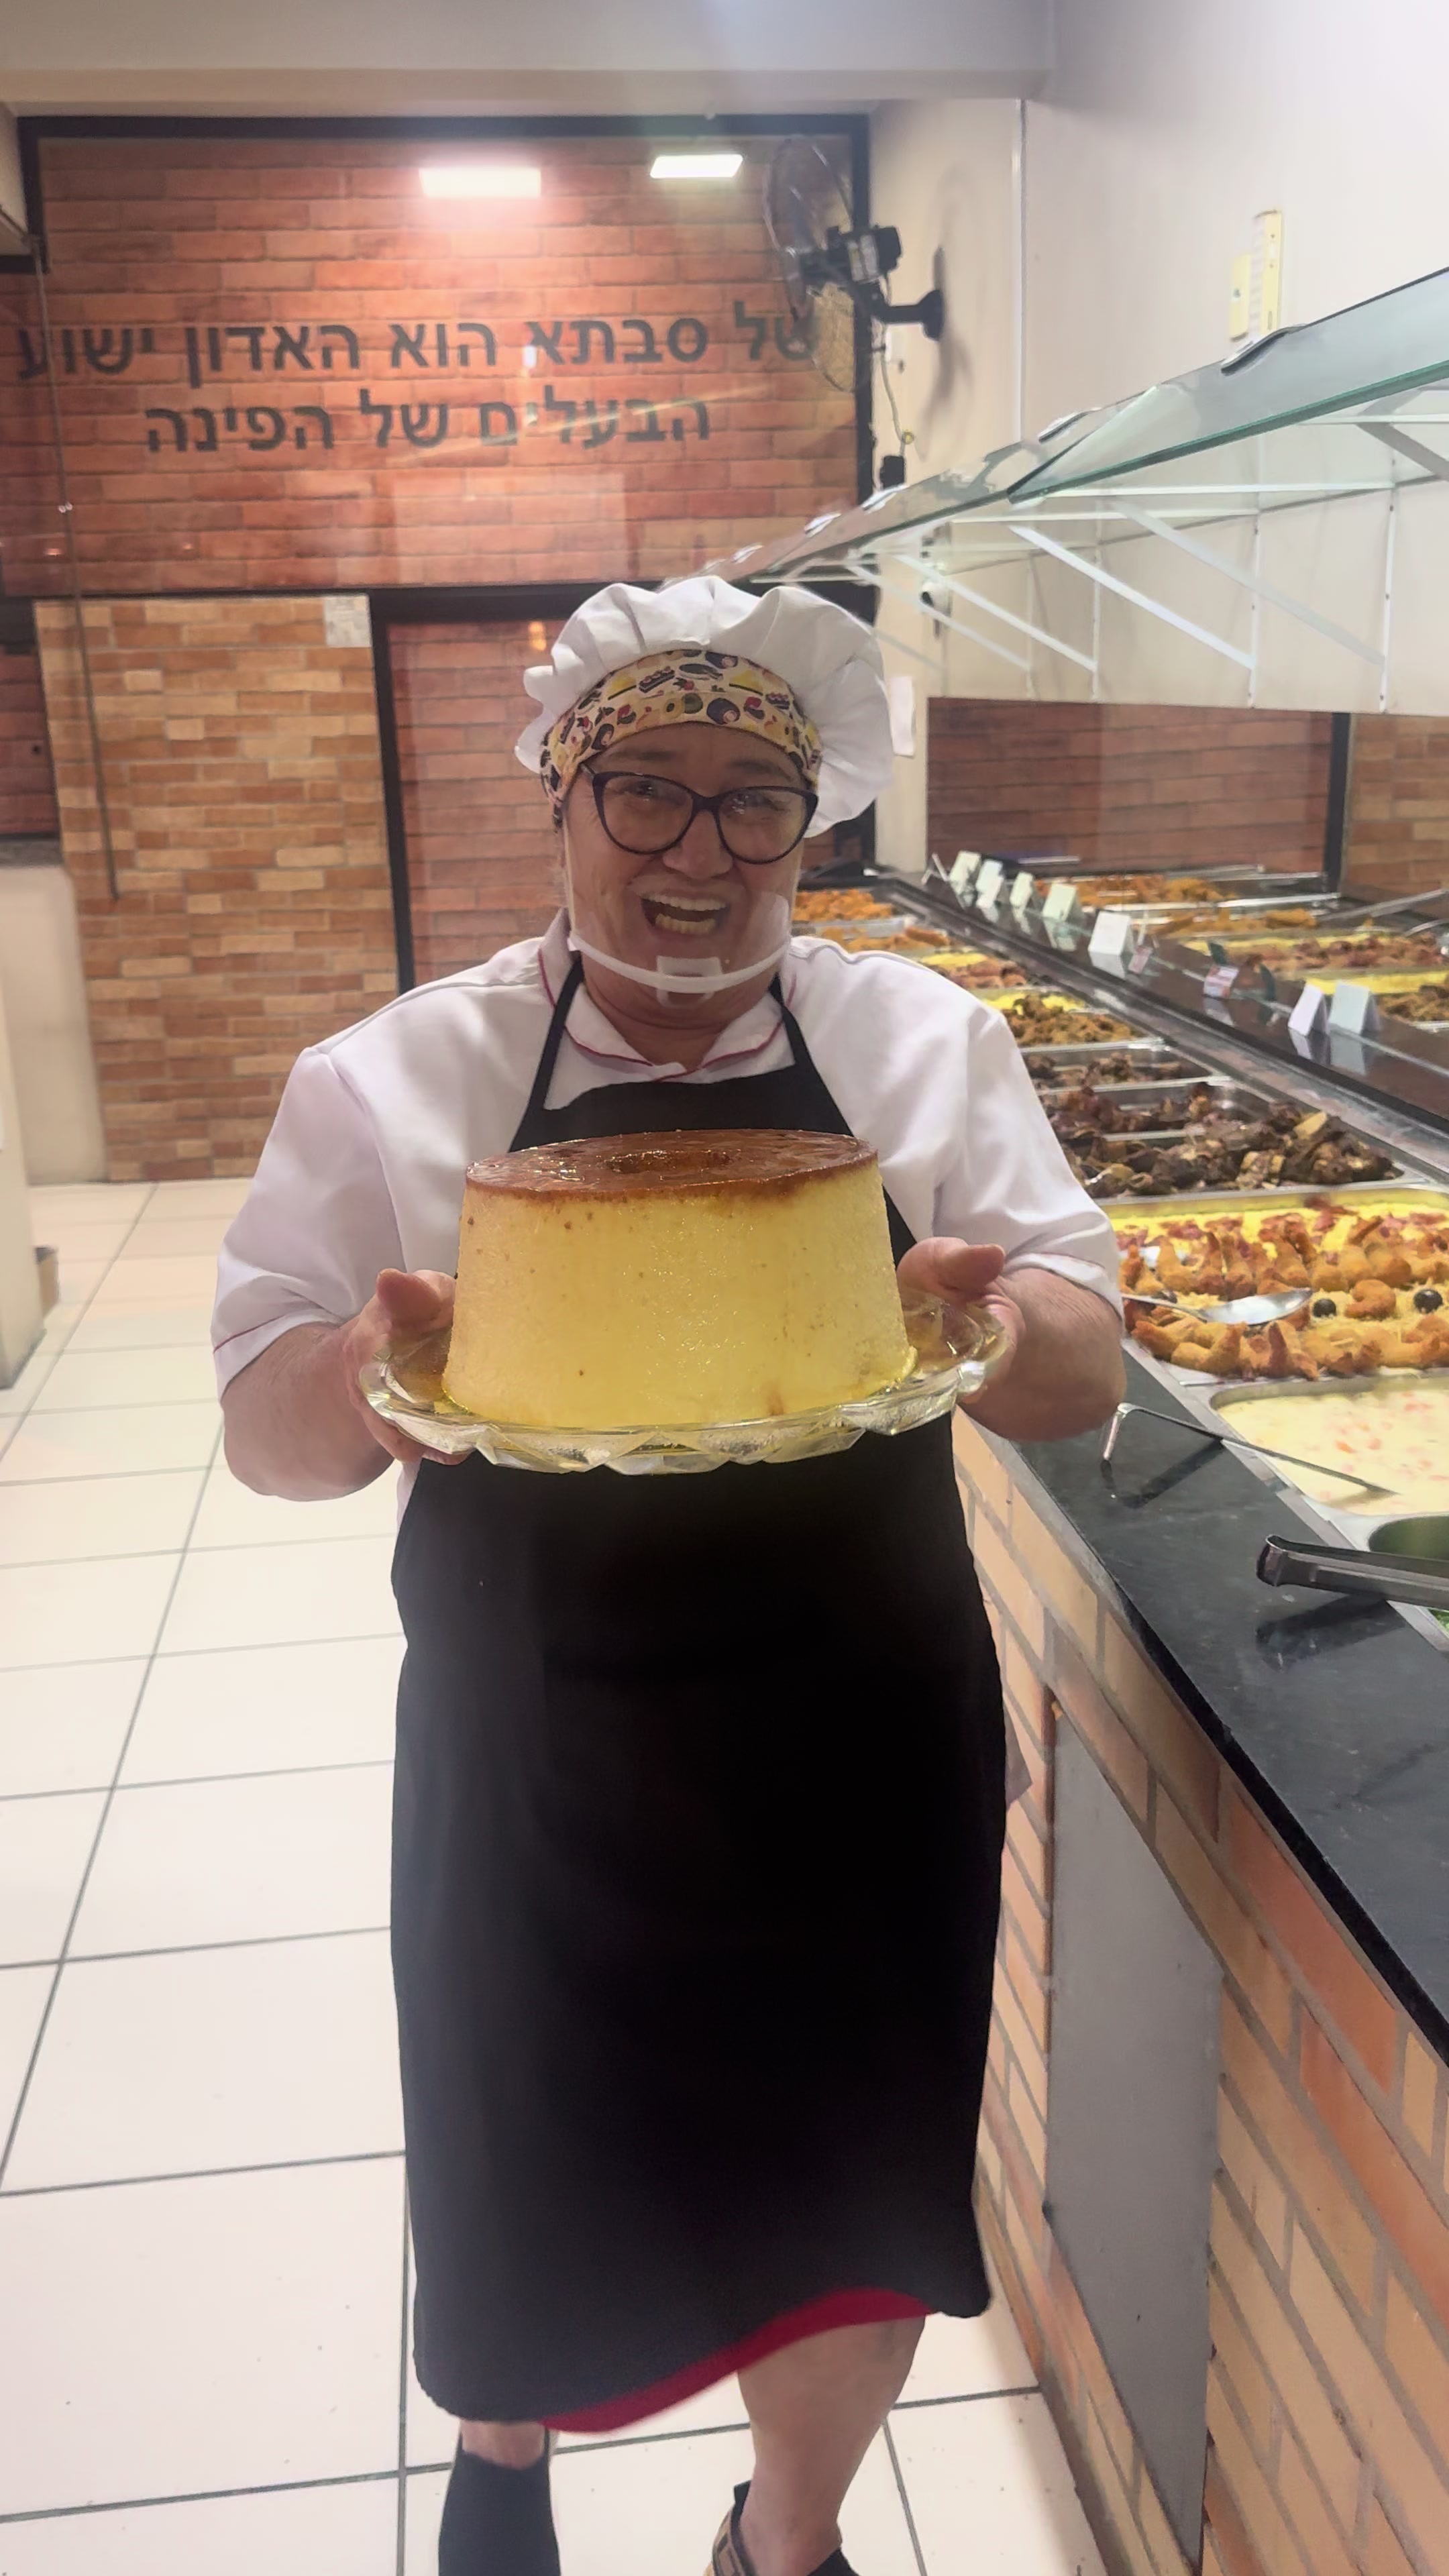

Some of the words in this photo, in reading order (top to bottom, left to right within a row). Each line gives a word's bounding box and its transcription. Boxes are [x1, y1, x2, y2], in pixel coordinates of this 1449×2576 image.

[18, 327, 154, 379] ישוע
[184, 324, 360, 389] האדון
[390, 322, 497, 368] הוא
[525, 317, 708, 365] סבתא
[145, 406, 335, 452] הפינה
[360, 388, 449, 449] של
[479, 384, 710, 449] הבעלים
